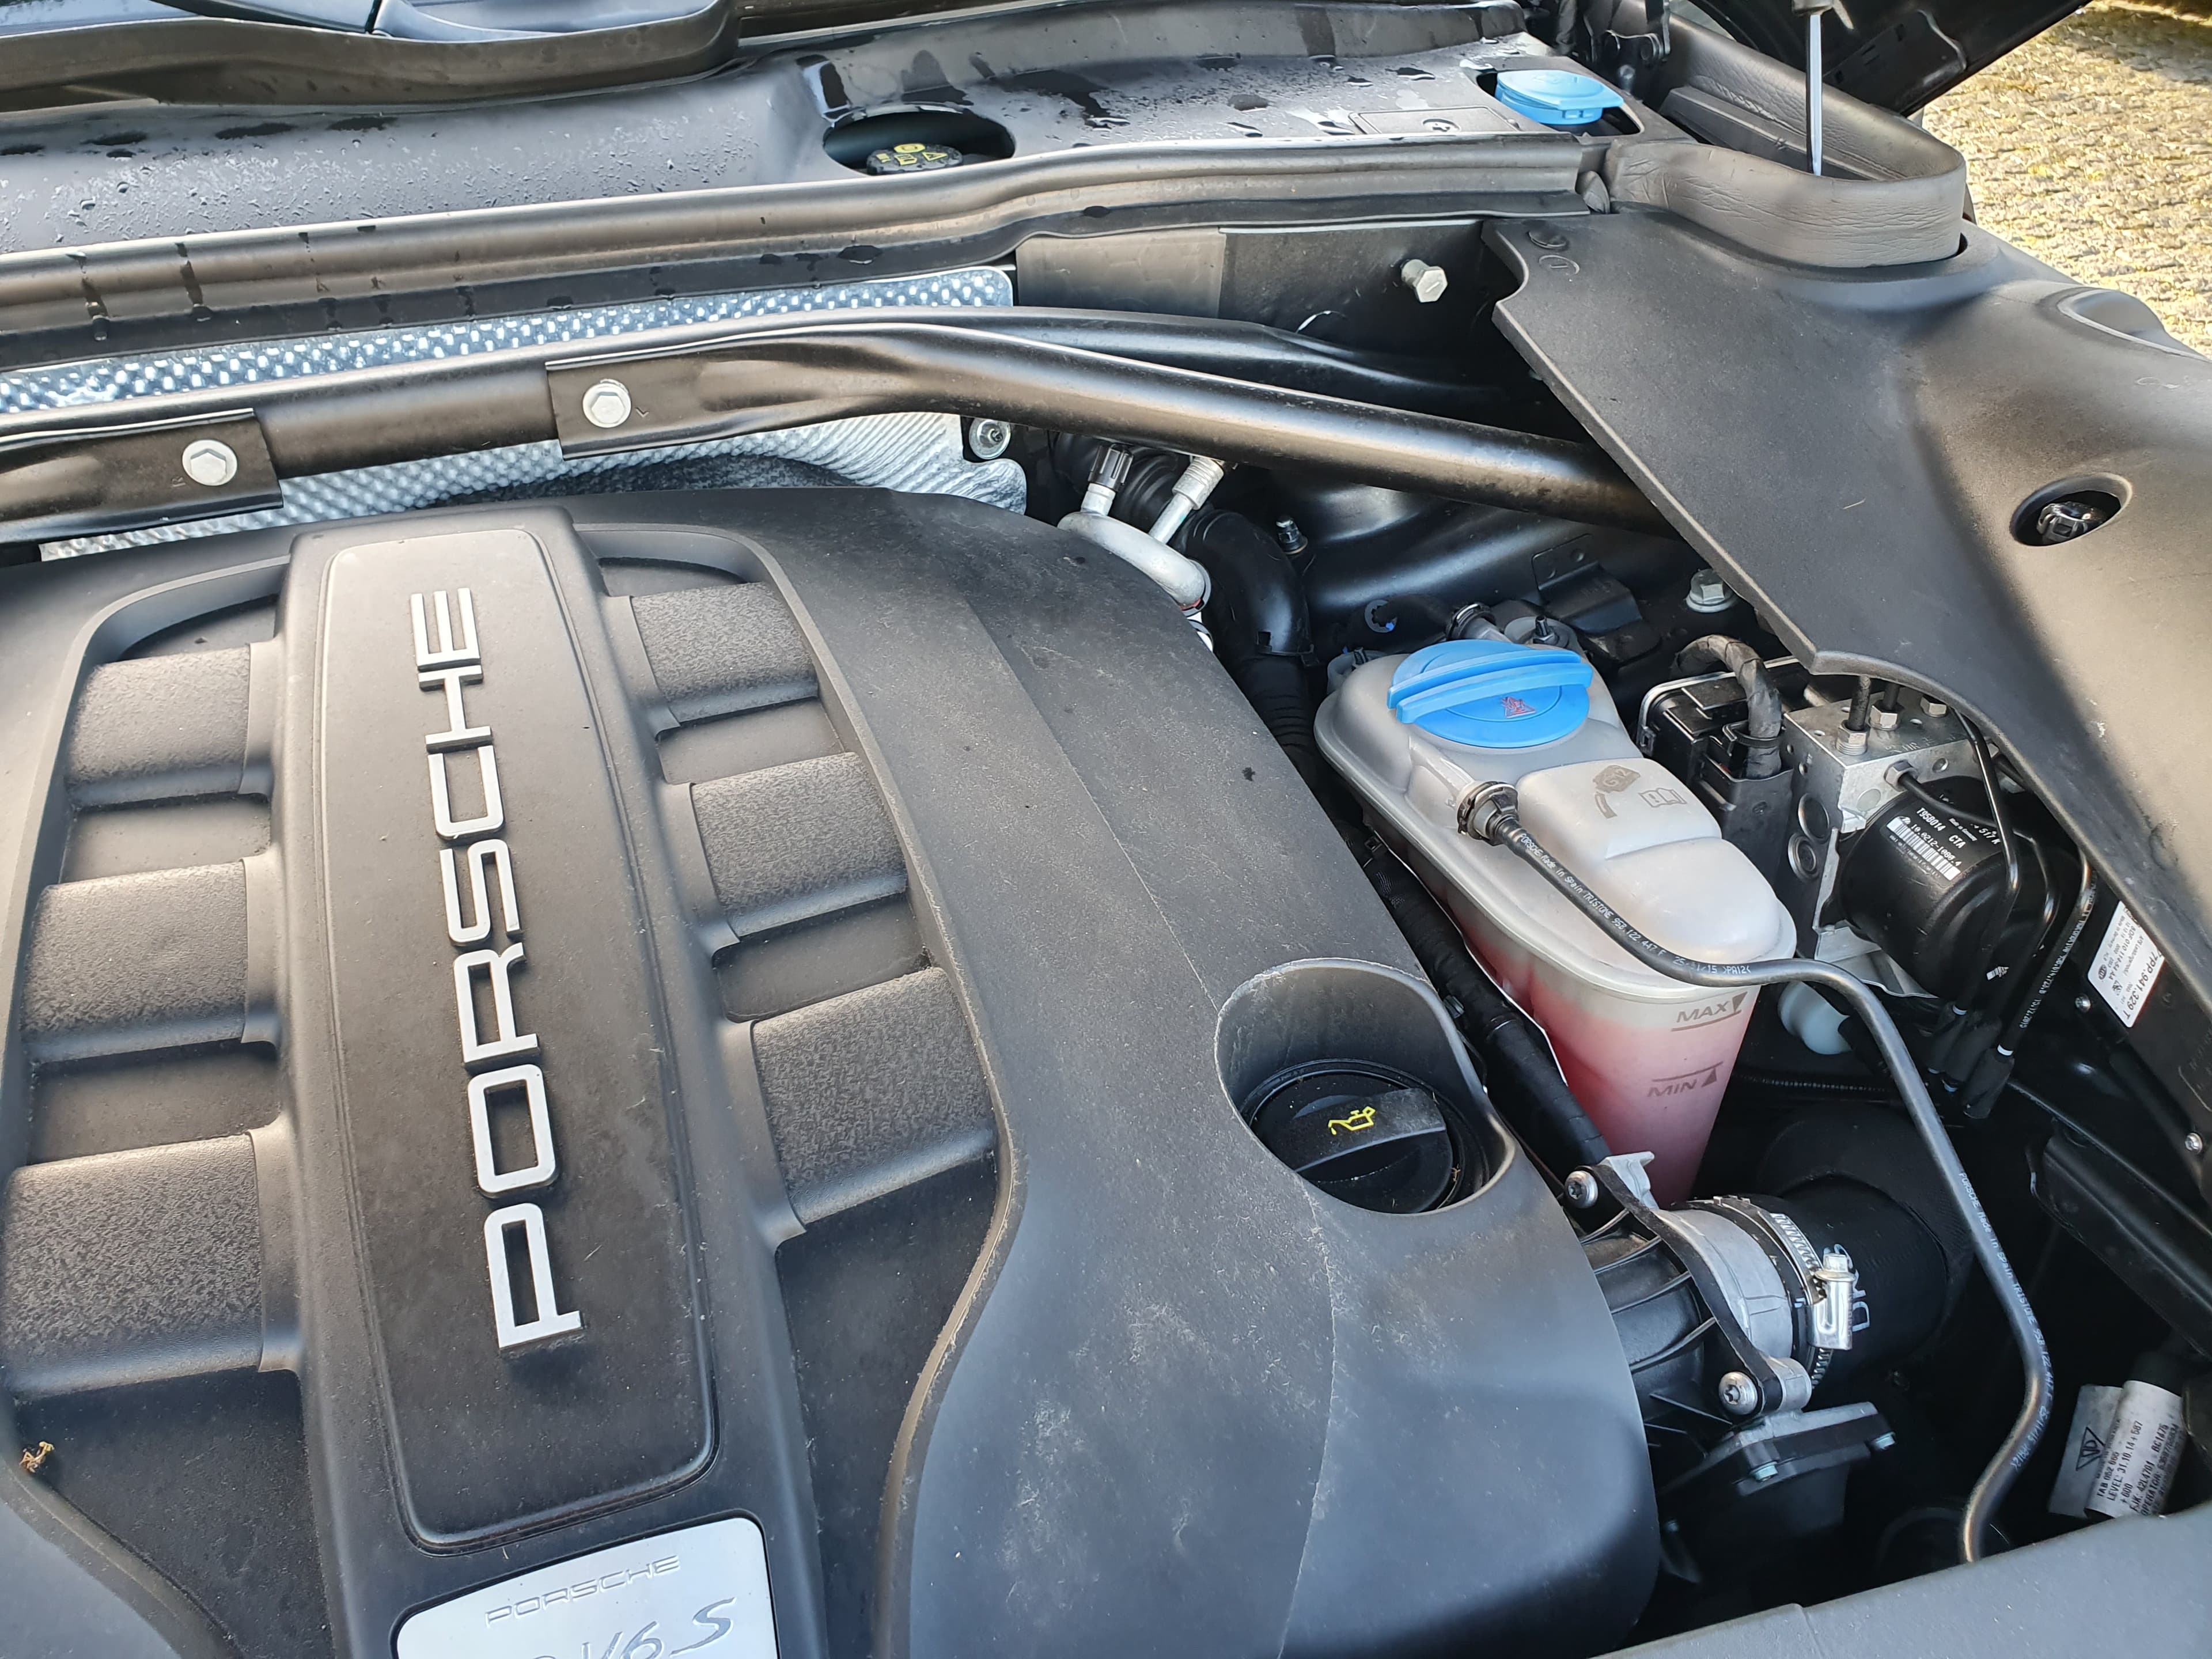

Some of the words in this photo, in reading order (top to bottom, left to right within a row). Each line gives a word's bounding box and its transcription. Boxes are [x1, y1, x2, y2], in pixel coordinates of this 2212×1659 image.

[1916, 806, 1946, 831] T95B014
[1948, 834, 1966, 849] CTA
[1517, 832, 1543, 857] PORSCHE
[1539, 852, 1556, 869] Made
[1585, 891, 1615, 919] TRISTONE
[410, 588, 580, 1349] PORSCHE
[1676, 1001, 1730, 1022] MAX
[1647, 1080, 1697, 1097] MIN
[486, 1555, 680, 1627] PORSCHE
[669, 1597, 737, 1657] S
